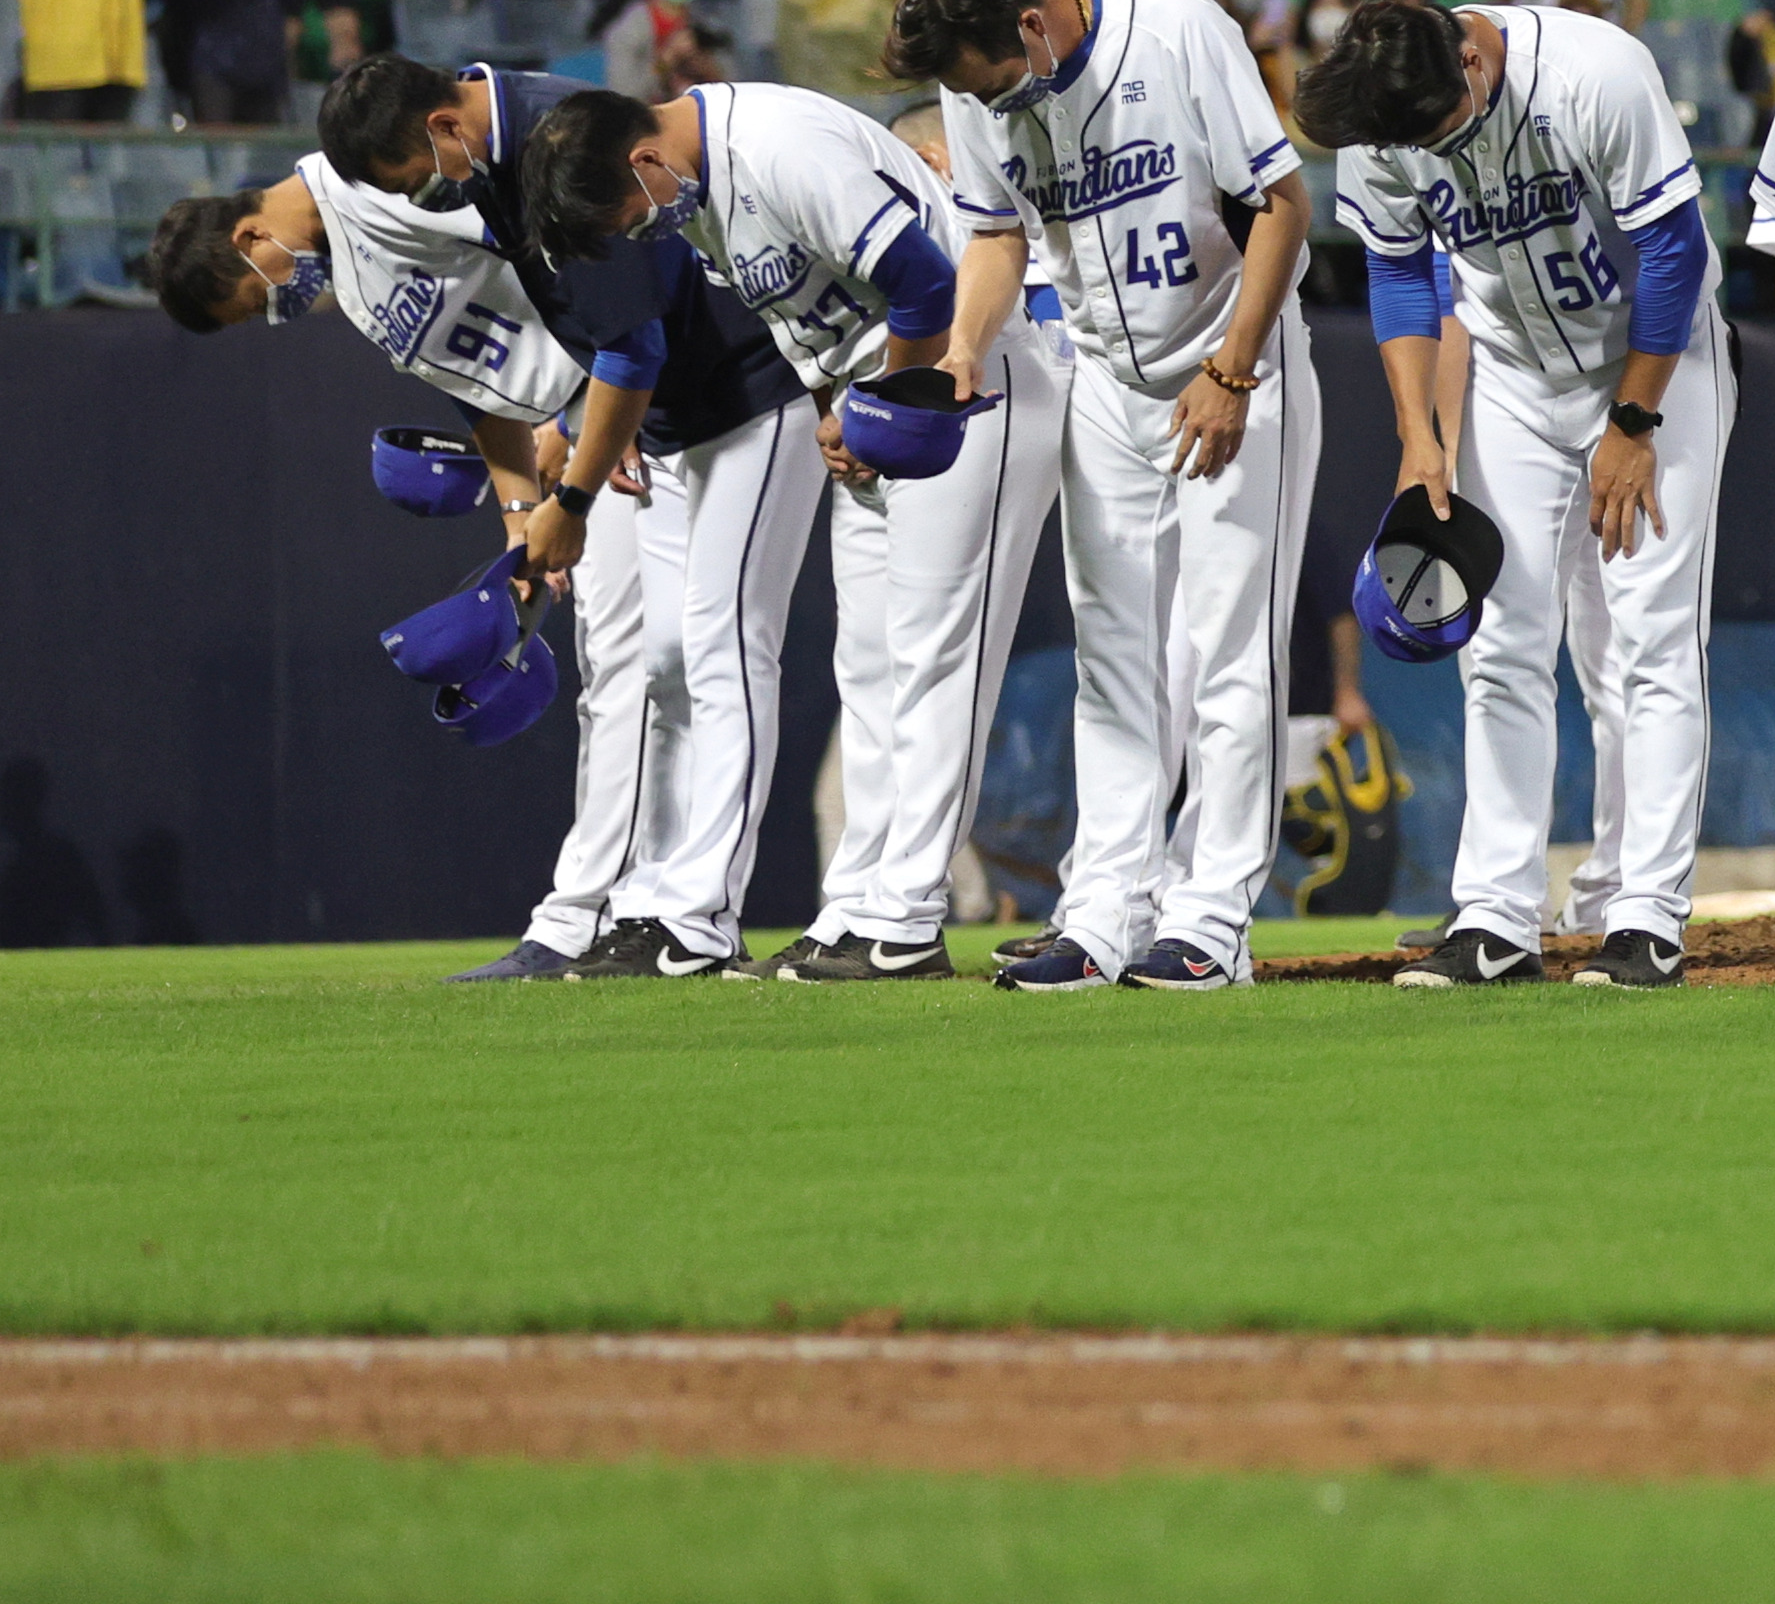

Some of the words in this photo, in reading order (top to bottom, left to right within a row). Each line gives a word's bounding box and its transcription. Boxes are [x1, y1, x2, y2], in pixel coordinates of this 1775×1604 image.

[1126, 221, 1200, 290] 42
[1542, 230, 1619, 312] 56
[445, 301, 524, 373] 91
